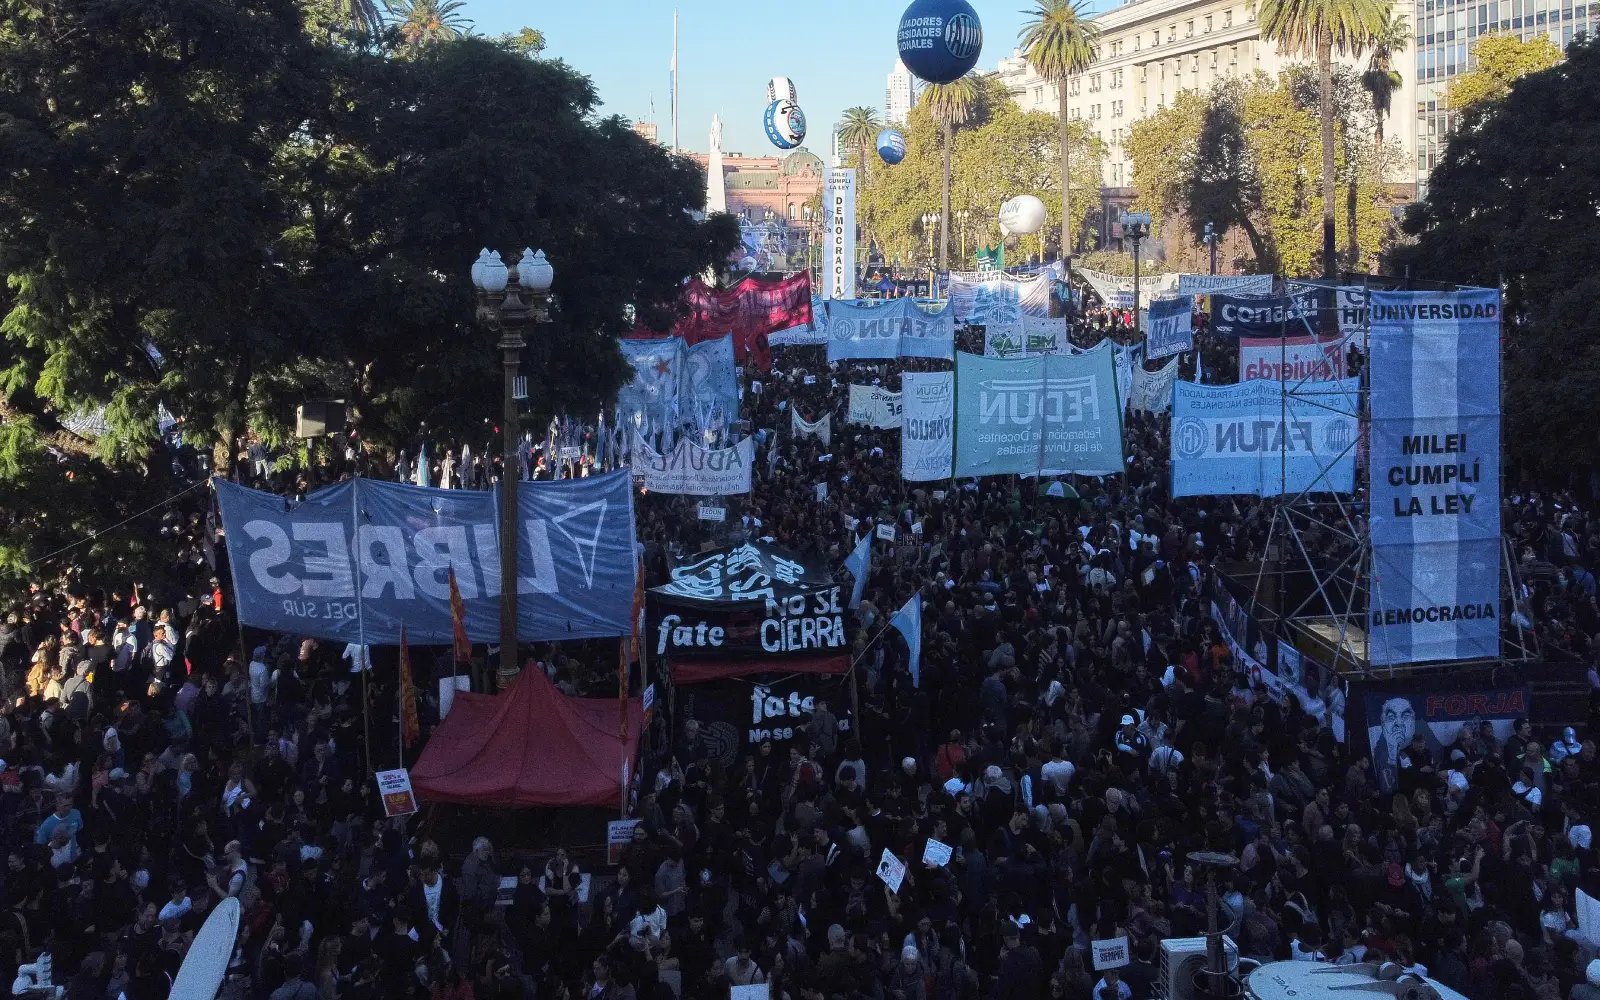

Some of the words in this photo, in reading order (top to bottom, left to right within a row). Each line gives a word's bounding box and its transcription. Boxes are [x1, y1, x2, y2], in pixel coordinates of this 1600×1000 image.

[834, 196, 845, 295] DEMOCRACIA
[1373, 303, 1498, 322] UNIVERSIDAD
[1403, 433, 1467, 456] MILEI
[1388, 457, 1481, 487] CUMPLÍ
[1393, 495, 1423, 517] LA
[1431, 494, 1476, 516] LEY
[765, 595, 805, 619] NO
[814, 586, 844, 615] SE
[1372, 602, 1496, 627] DEMOCRACIA
[657, 614, 725, 655] fate
[1426, 689, 1526, 717] FORJA
